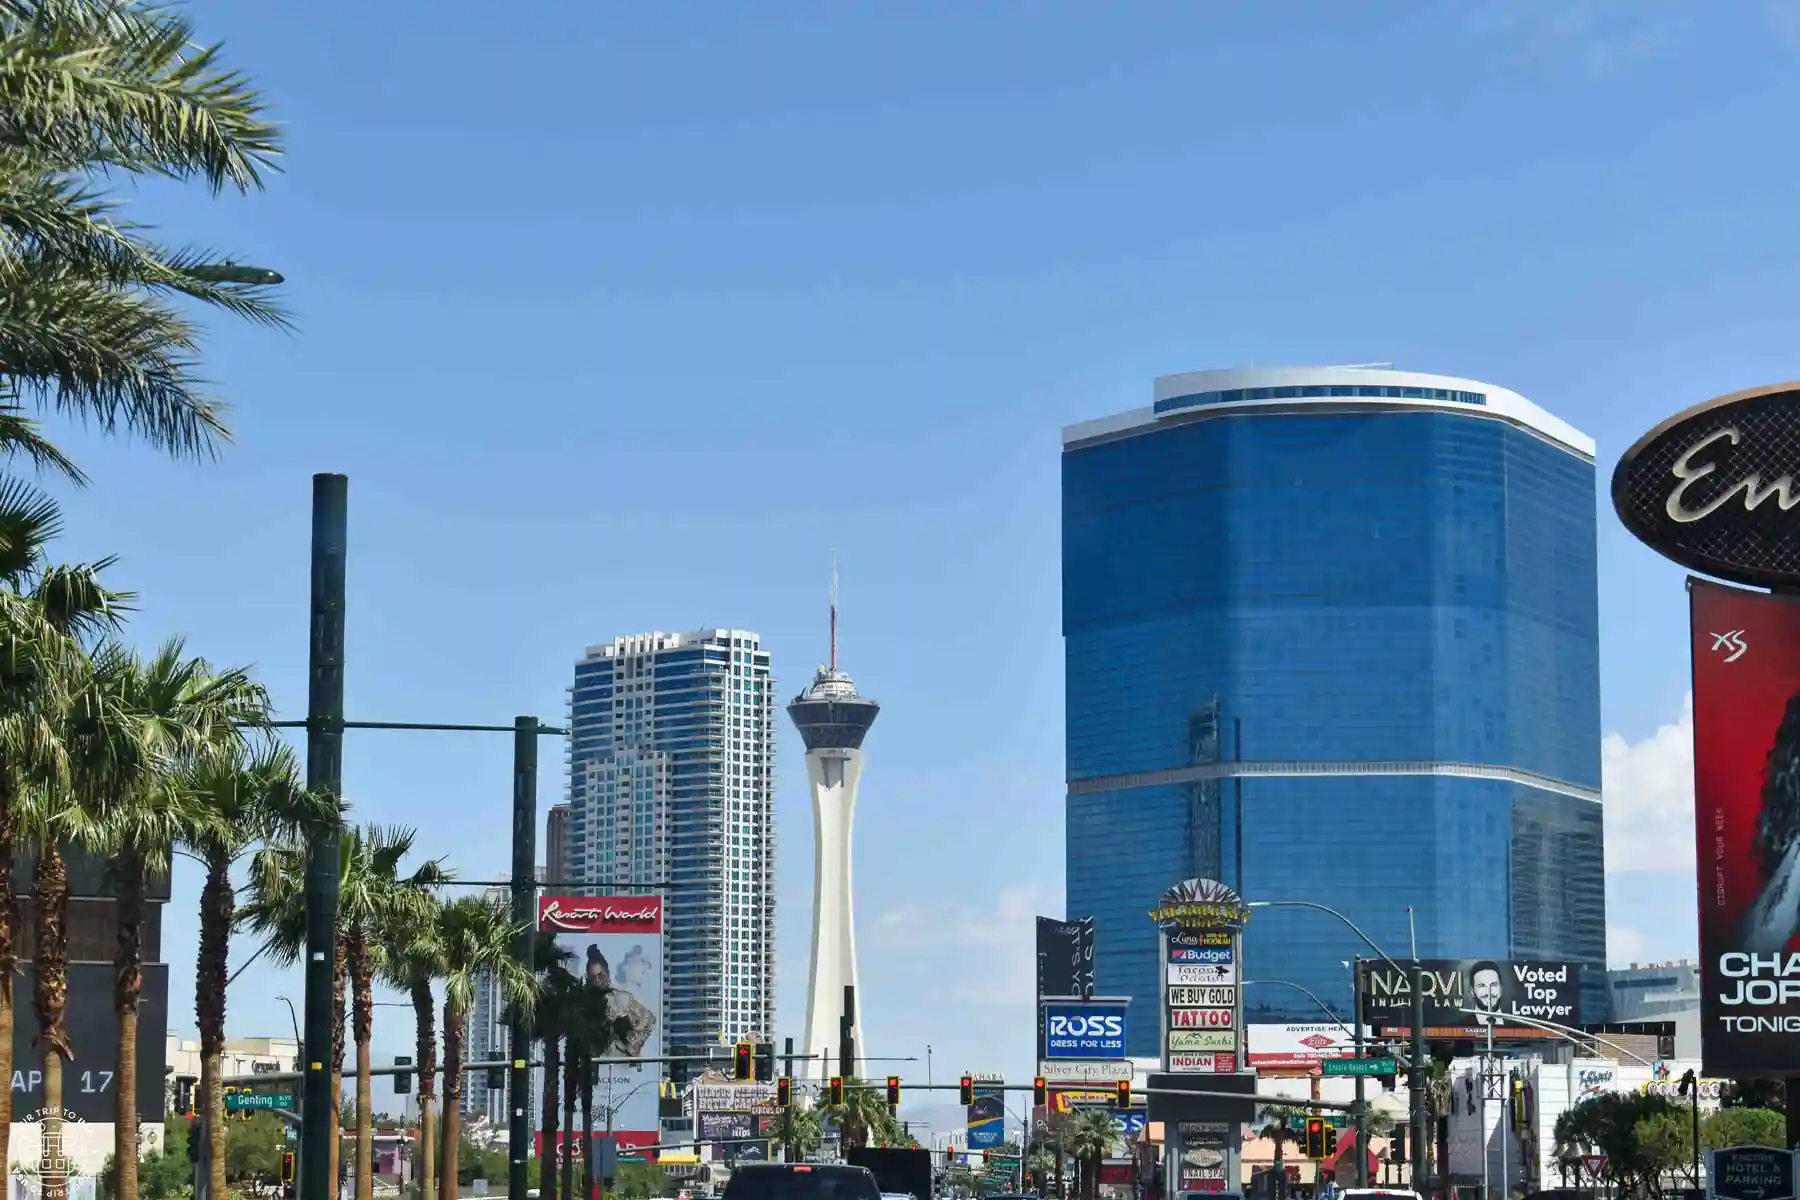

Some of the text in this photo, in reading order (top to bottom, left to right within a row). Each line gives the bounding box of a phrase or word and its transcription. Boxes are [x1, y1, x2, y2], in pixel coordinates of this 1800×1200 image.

[1666, 426, 1800, 522] En
[1709, 630, 1748, 662] XS
[541, 900, 659, 929] Resorts World
[1187, 949, 1231, 962] Budget
[1514, 965, 1567, 982] Voted
[1371, 971, 1464, 996] NAQVI
[1171, 988, 1233, 1003] WE BUY GOLD
[1524, 983, 1557, 1003] Top
[1434, 998, 1464, 1007] LAW
[1512, 1001, 1572, 1018] Lawyer
[1172, 1011, 1232, 1025] TATTOO
[1719, 1016, 1800, 1032] TONIG
[1050, 1016, 1122, 1036] ROSS
[1172, 1035, 1233, 1047] Yama Sushi
[1173, 1058, 1211, 1066] INDIAN
[973, 1073, 1003, 1081] AHARA
[1044, 1064, 1129, 1077] Silver City Plaza
[11, 1070, 114, 1092] AP 17
[238, 1094, 273, 1107] Genting
[1726, 1164, 1768, 1172] HOTEL
[1725, 1176, 1782, 1186] PARKING
